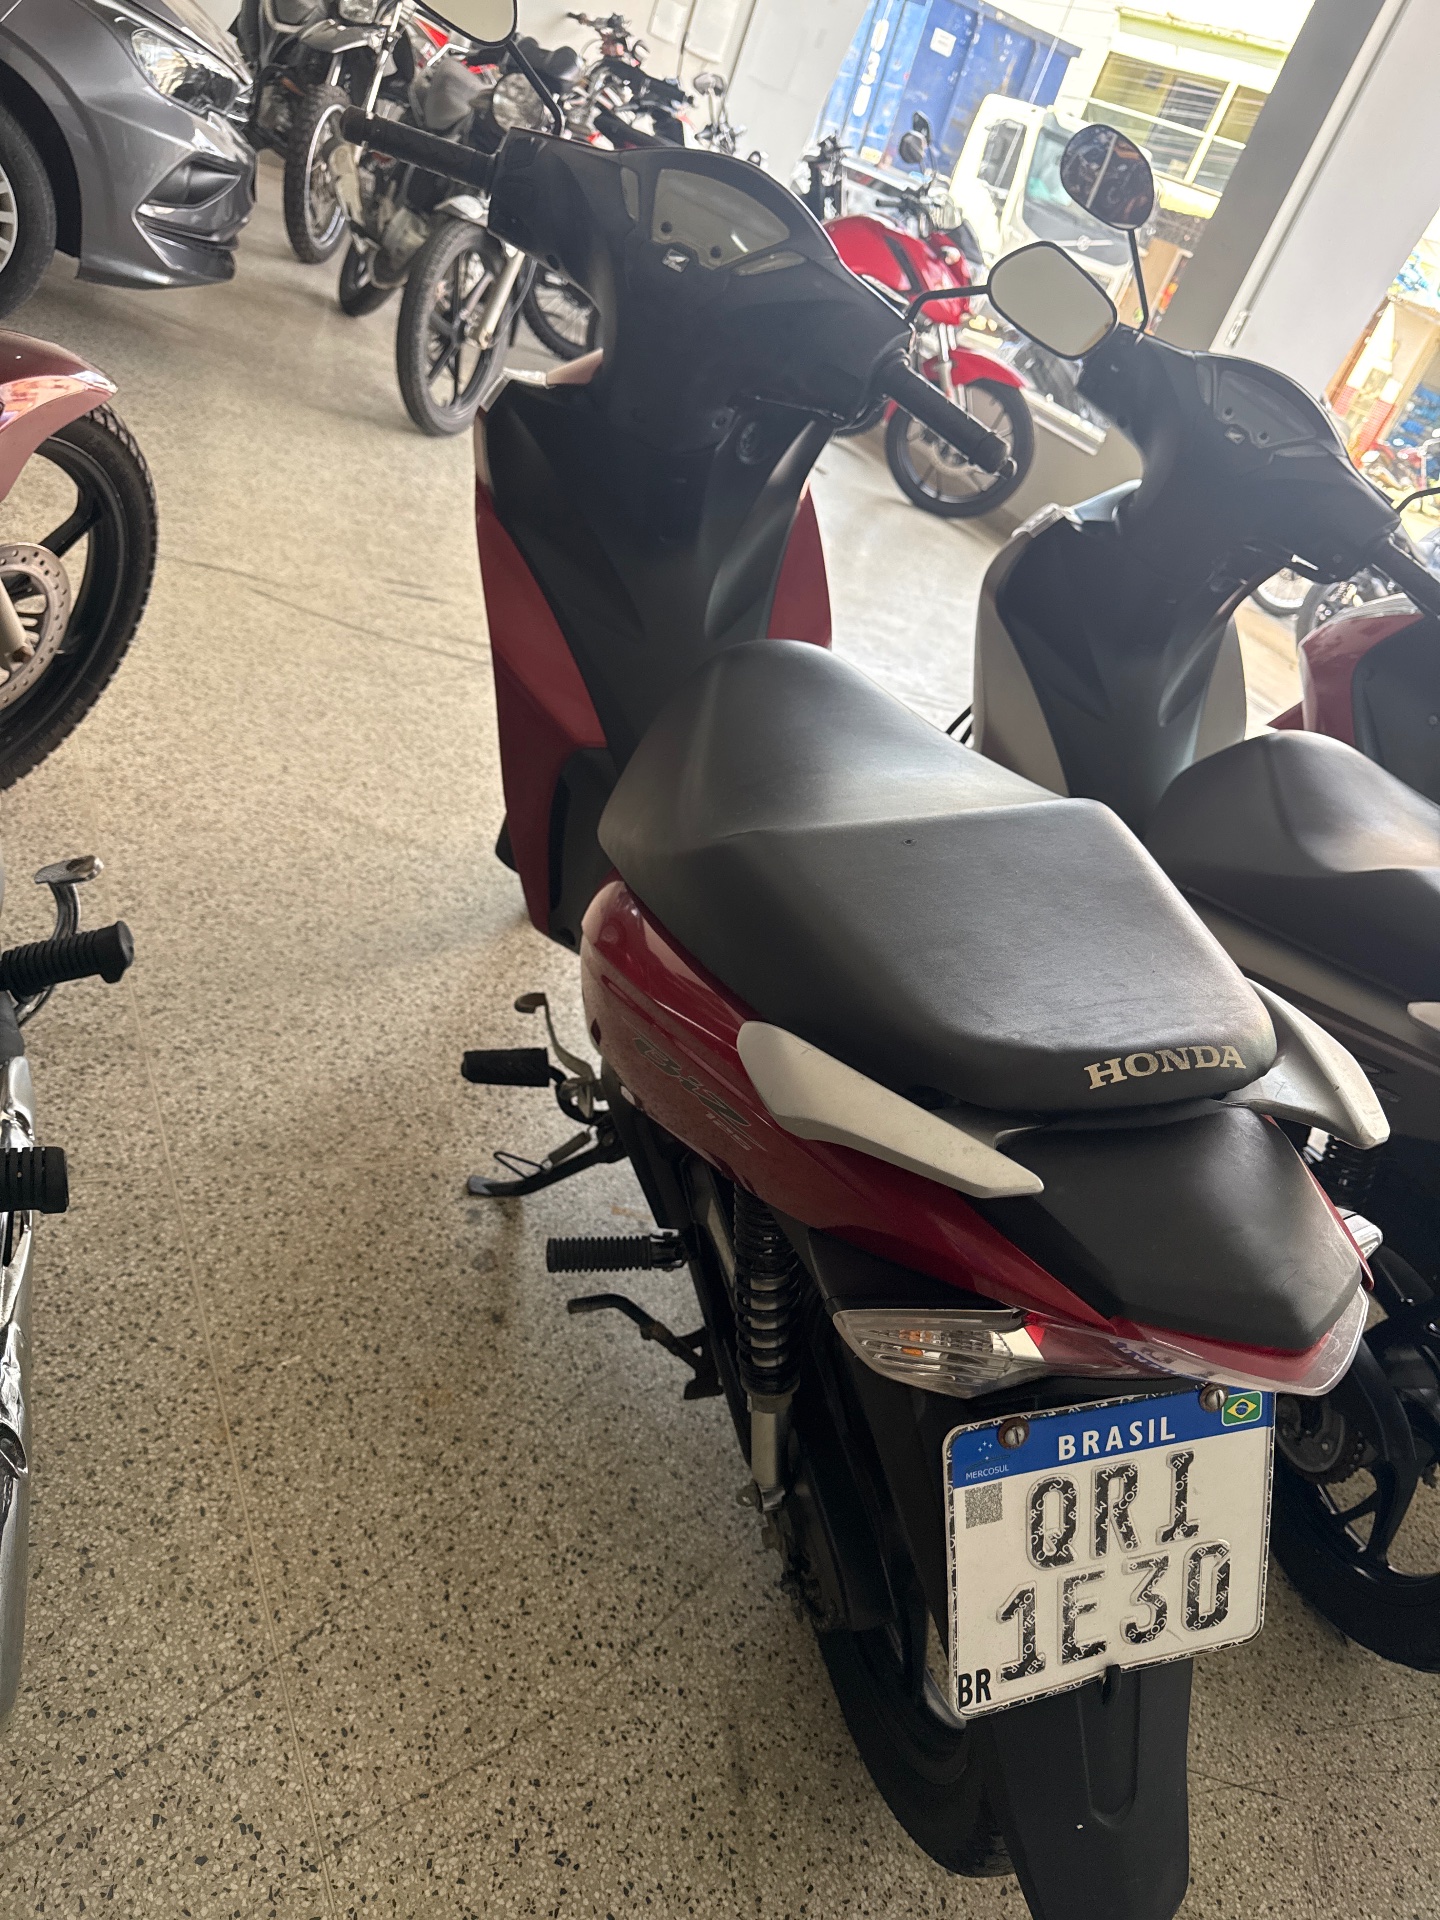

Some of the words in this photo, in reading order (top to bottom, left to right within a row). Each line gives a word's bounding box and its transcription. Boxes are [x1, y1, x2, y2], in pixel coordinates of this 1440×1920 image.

[1083, 1045, 1247, 1090] HONDA
[705, 1110, 753, 1151] 125
[1057, 1416, 1177, 1461] BRASIL
[965, 1464, 1010, 1481] MERCOSUL
[1028, 1449, 1201, 1569] QRI
[998, 1542, 1232, 1684] 1E30
[957, 1667, 993, 1708] BR
